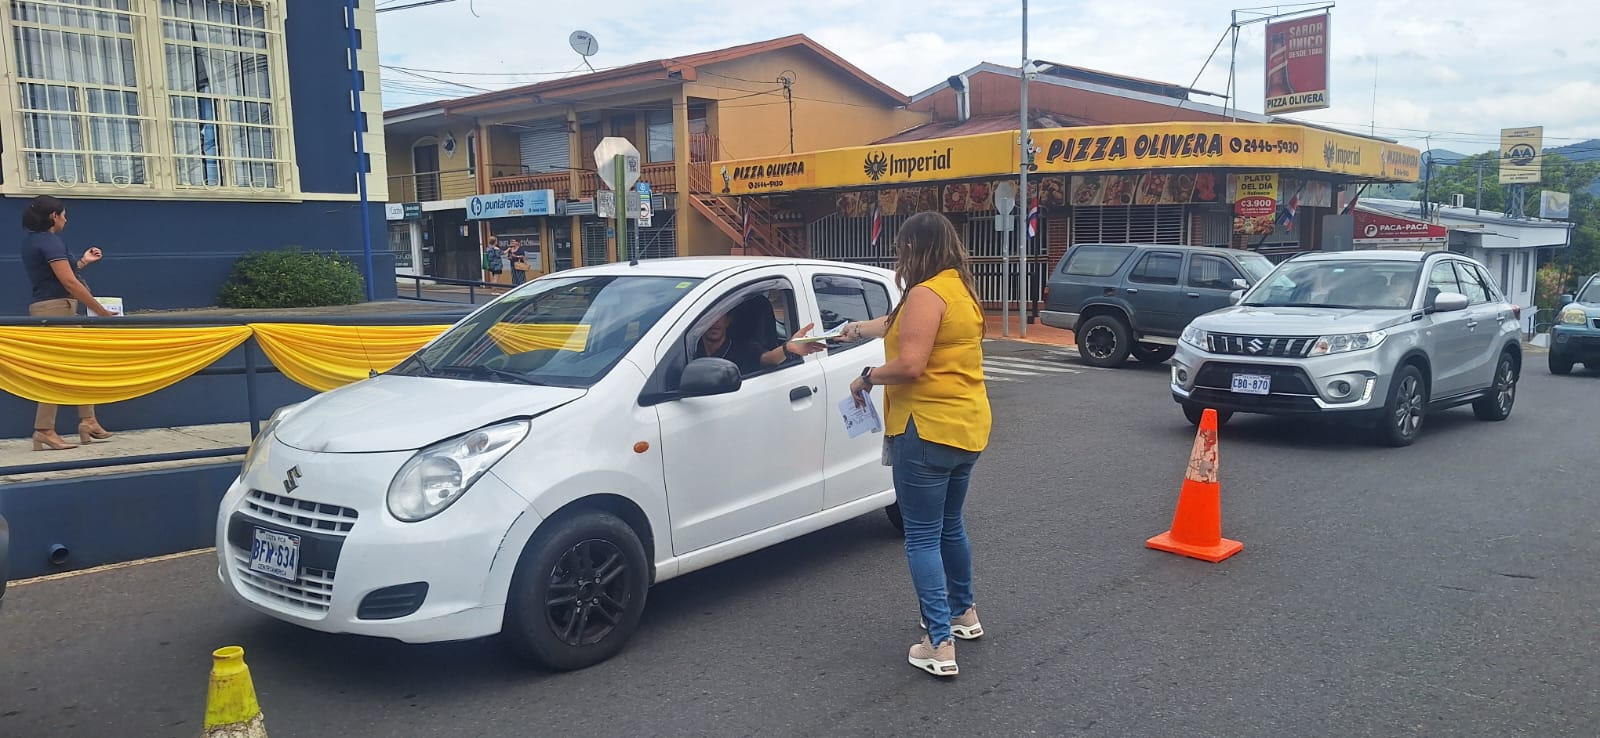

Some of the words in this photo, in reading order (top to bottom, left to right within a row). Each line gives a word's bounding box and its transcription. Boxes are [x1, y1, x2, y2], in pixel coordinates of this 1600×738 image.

[1289, 22, 1323, 38] SABOR
[1267, 97, 1288, 109] PIZZA
[1289, 93, 1324, 105] OLIVERA
[1046, 135, 1128, 164] PIZZA
[1133, 133, 1223, 159] OLIVERA
[1243, 138, 1299, 154] 2446-5930
[1335, 142, 1361, 169] Imperial
[889, 147, 952, 178] Imperial
[733, 165, 765, 181] PIZZA
[766, 161, 805, 178] OLIVERA
[1244, 174, 1272, 182] PLATO
[1258, 182, 1273, 190] DÍA
[484, 199, 525, 214] puntarenas
[1380, 223, 1429, 231] PACA-PACA
